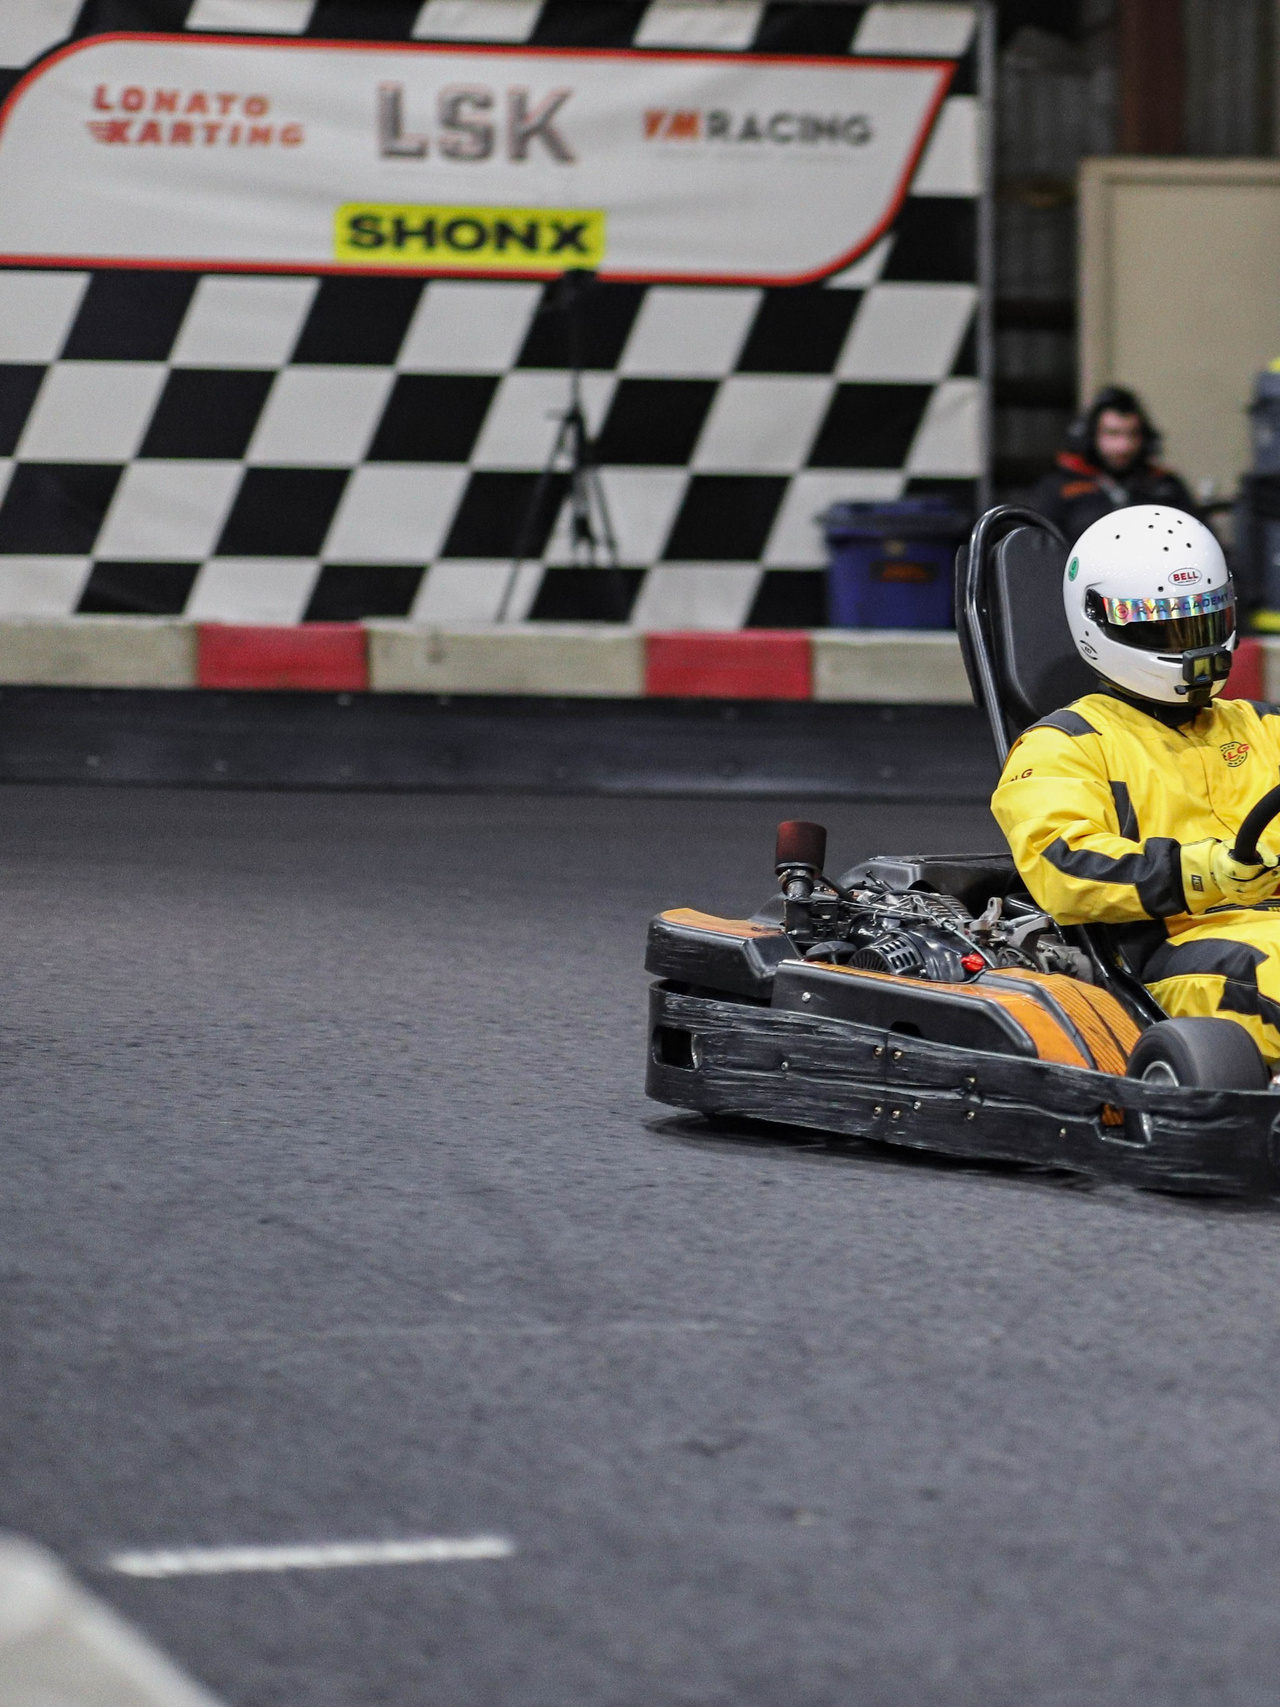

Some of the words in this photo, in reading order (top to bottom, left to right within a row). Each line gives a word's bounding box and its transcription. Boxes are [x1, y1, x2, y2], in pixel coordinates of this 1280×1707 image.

[93, 83, 269, 119] LONATO
[86, 119, 304, 148] KARTING
[377, 80, 577, 166] LSK
[348, 213, 590, 255] SHONX
[1173, 571, 1199, 582] BELL
